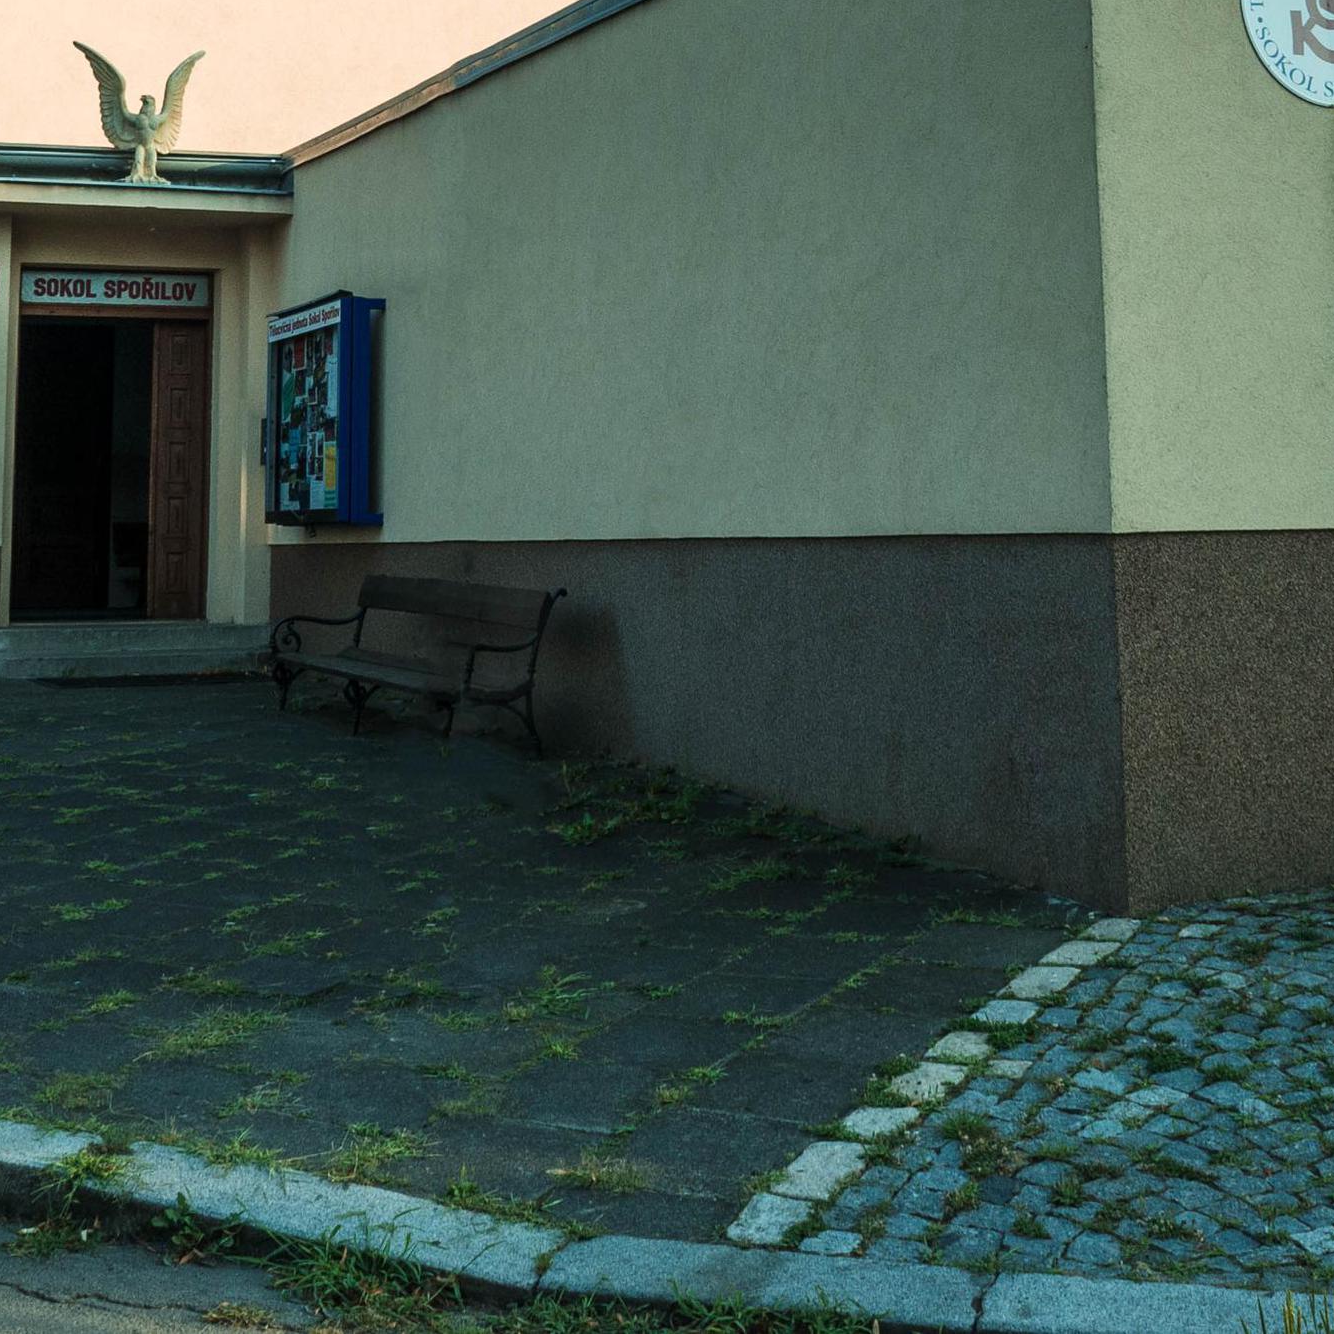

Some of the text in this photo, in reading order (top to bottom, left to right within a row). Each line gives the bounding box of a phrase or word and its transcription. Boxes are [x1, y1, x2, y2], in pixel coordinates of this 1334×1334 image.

[1255, 26, 1318, 94] SOKOL
[33, 277, 197, 301] SOKOL SPOŘILOV
